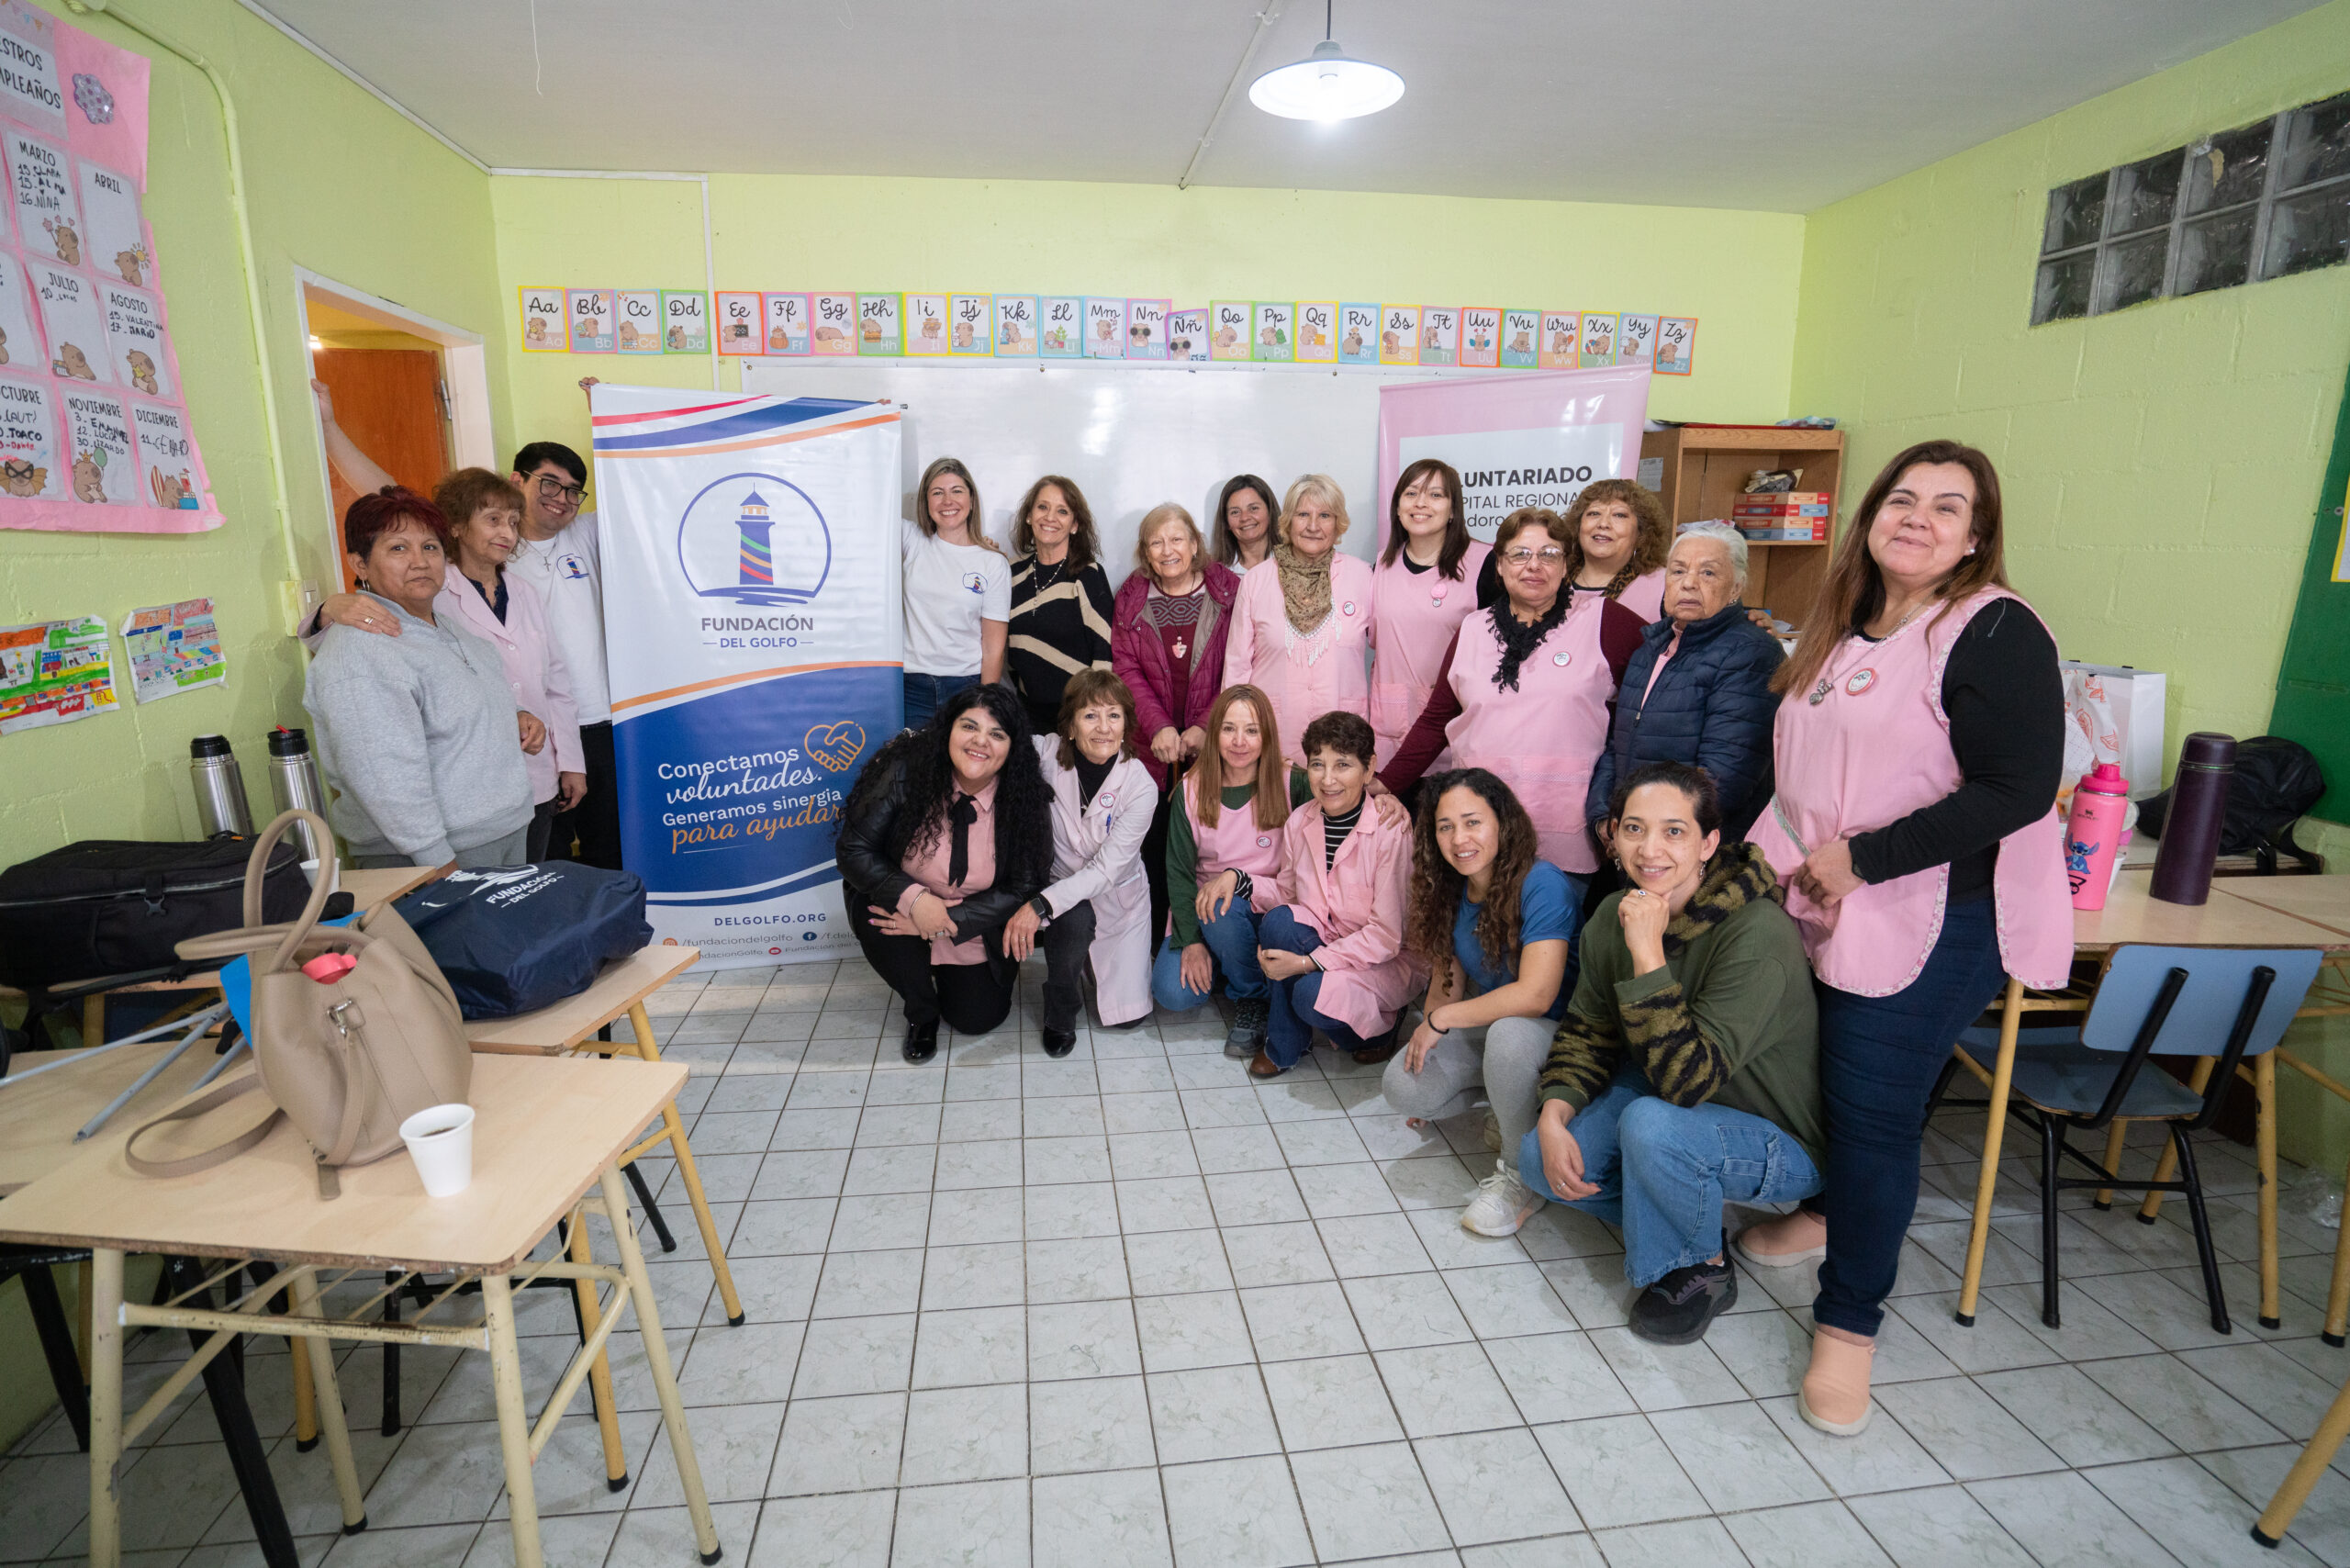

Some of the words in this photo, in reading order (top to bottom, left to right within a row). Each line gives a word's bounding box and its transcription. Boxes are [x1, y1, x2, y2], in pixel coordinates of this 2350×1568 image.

[0, 38, 42, 72] STROS
[19, 140, 56, 166] MARZO
[95, 173, 121, 194] ABRIL
[48, 272, 79, 293] JULIO
[111, 292, 147, 314] AGOSTO
[529, 297, 558, 313] Aa
[576, 294, 606, 315] Bb
[627, 300, 651, 317] Cc
[669, 297, 700, 316] Dd
[730, 302, 750, 317] Ee
[774, 300, 796, 321] Ff
[820, 297, 847, 319] Gg
[862, 299, 893, 317] Hh
[959, 299, 980, 321] Jj
[1001, 301, 1030, 321] Kk
[1051, 303, 1072, 320] Ll
[1091, 305, 1120, 319] Mm
[1136, 306, 1163, 320] Nn
[1221, 308, 1244, 323] Oo
[1264, 308, 1286, 328] Pp
[1306, 308, 1327, 329] Qq
[1348, 310, 1372, 327] Rr
[1390, 311, 1414, 330] Ss
[1432, 314, 1452, 330] Tt
[1469, 312, 1494, 328] Uu
[1509, 315, 1533, 330] Vv
[1174, 316, 1202, 334] Ññ
[1547, 317, 1576, 331] Ww
[1588, 319, 1613, 333] Xx
[1628, 318, 1651, 340] Yy
[1664, 323, 1687, 343] Zz
[0, 386, 41, 405] CTUBRE
[68, 397, 122, 419] NOVIEMBRE
[136, 409, 178, 429] DICIEMBRE
[1461, 465, 1593, 487] UNTARIADO
[701, 614, 813, 632] FUNDACIÓN
[721, 638, 746, 648] DEL
[750, 637, 797, 648] GOLFO
[657, 748, 800, 780] Conectamos
[666, 757, 822, 804] voluntades.
[662, 802, 767, 826] Generamos
[772, 789, 842, 811] sinergia
[672, 823, 740, 854] para
[745, 796, 841, 841] ayudar
[509, 892, 530, 903] DEL
[714, 913, 827, 926] DELGOLFO.ORG
